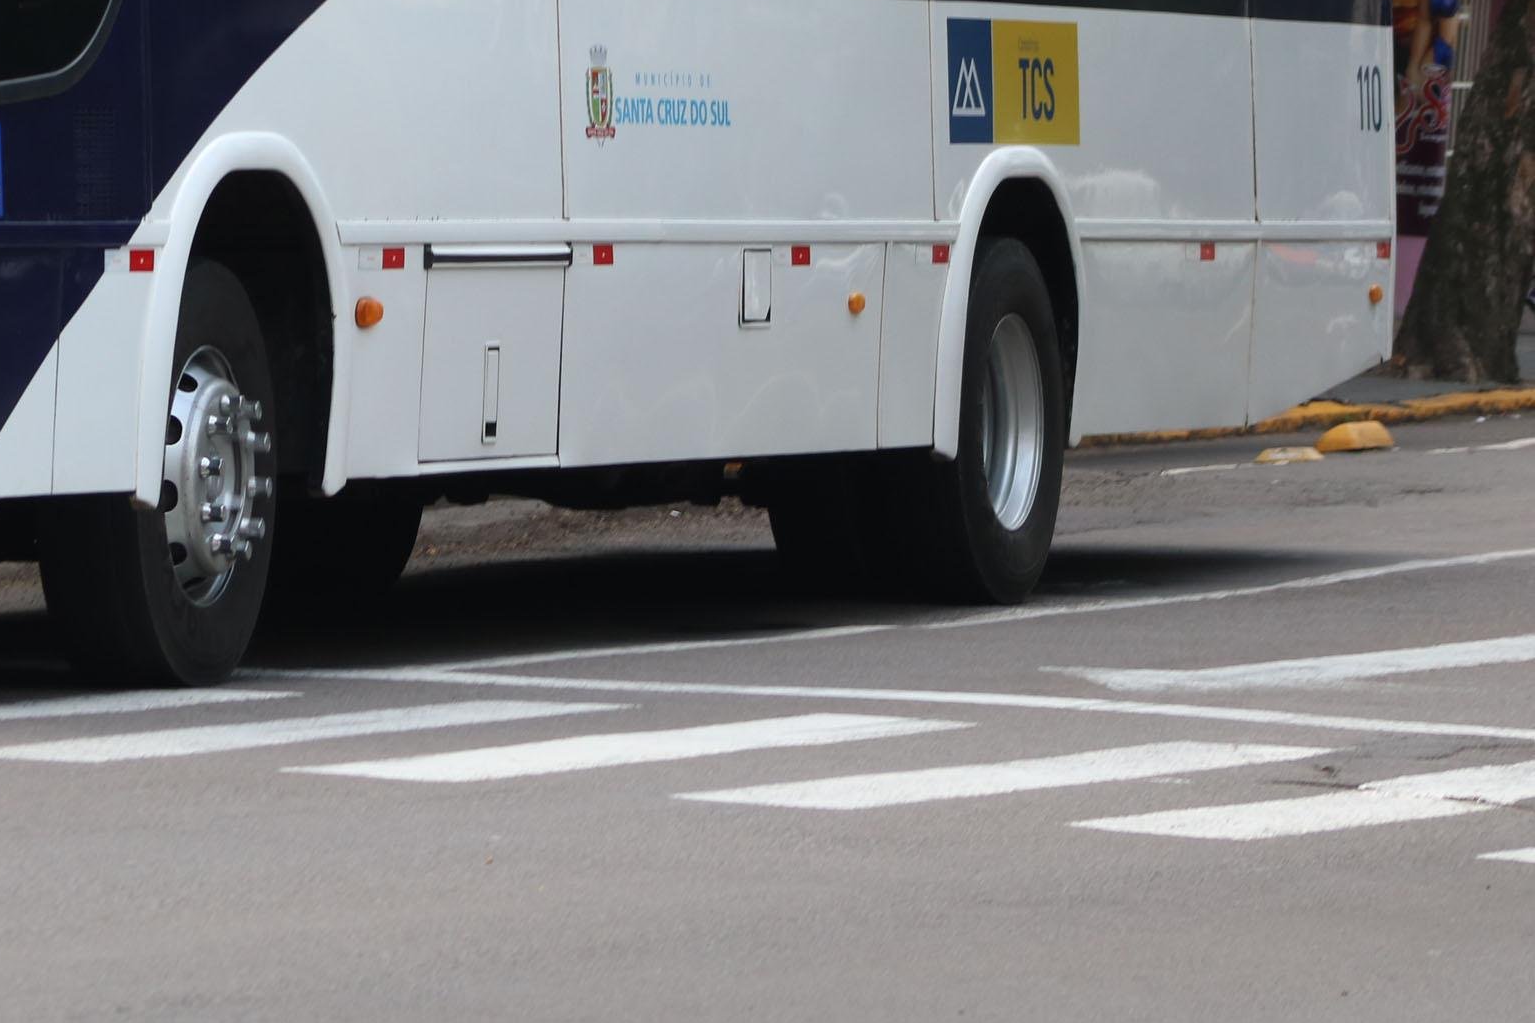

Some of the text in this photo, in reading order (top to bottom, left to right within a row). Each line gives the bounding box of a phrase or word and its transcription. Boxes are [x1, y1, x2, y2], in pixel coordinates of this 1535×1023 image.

[615, 96, 731, 126] SANTA CRUZ DO SUL
[1018, 58, 1055, 121] TCS
[1357, 65, 1382, 132] 110
